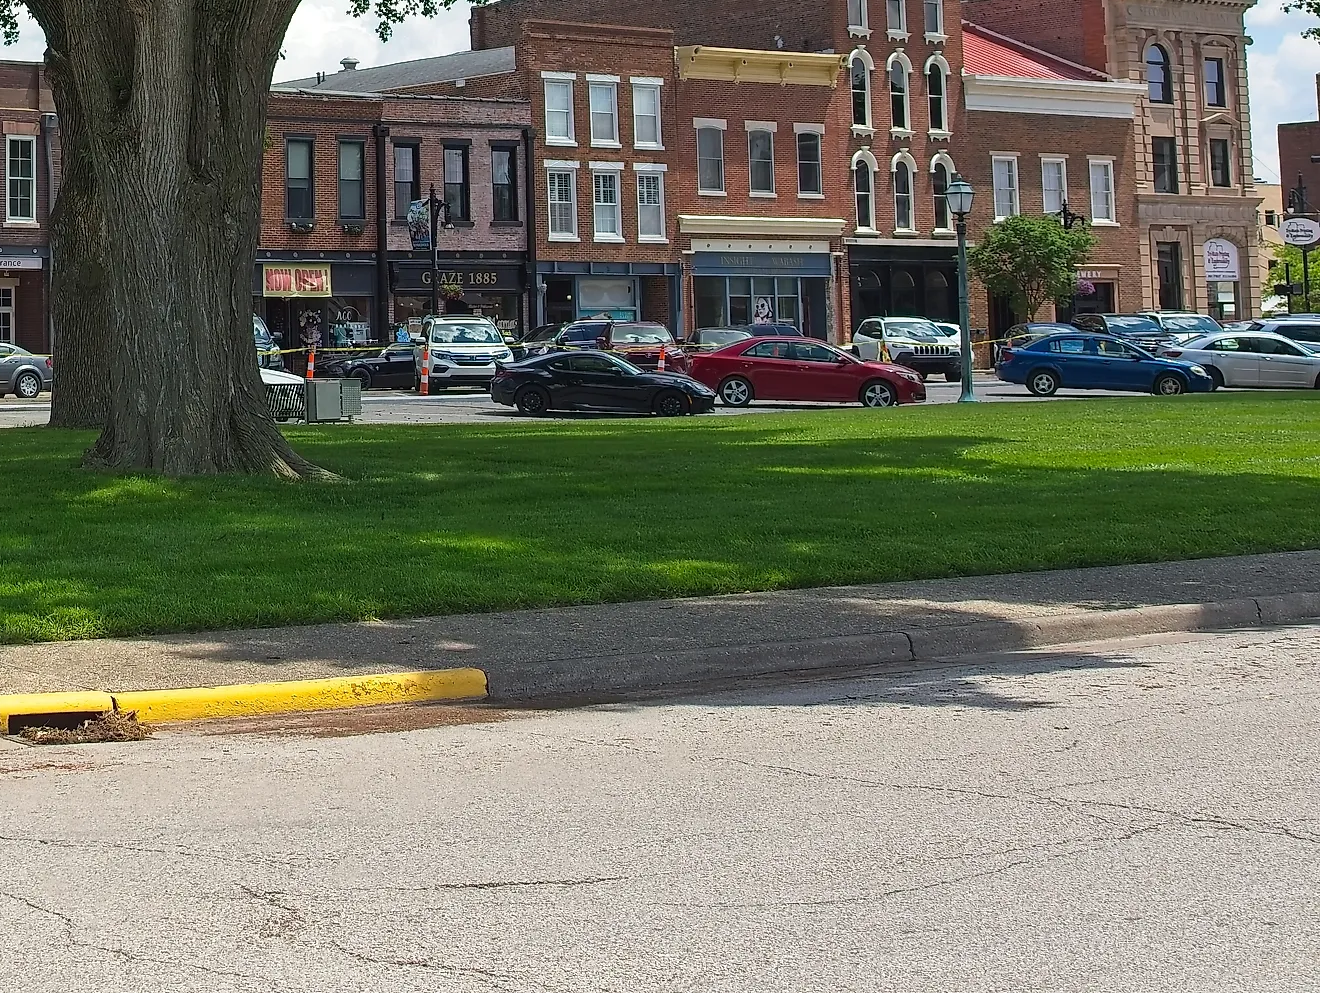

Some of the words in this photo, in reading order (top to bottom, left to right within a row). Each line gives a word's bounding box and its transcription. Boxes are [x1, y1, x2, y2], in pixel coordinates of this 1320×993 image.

[265, 269, 292, 291] NOW
[422, 271, 463, 284] GAZE
[469, 272, 497, 284] 1885
